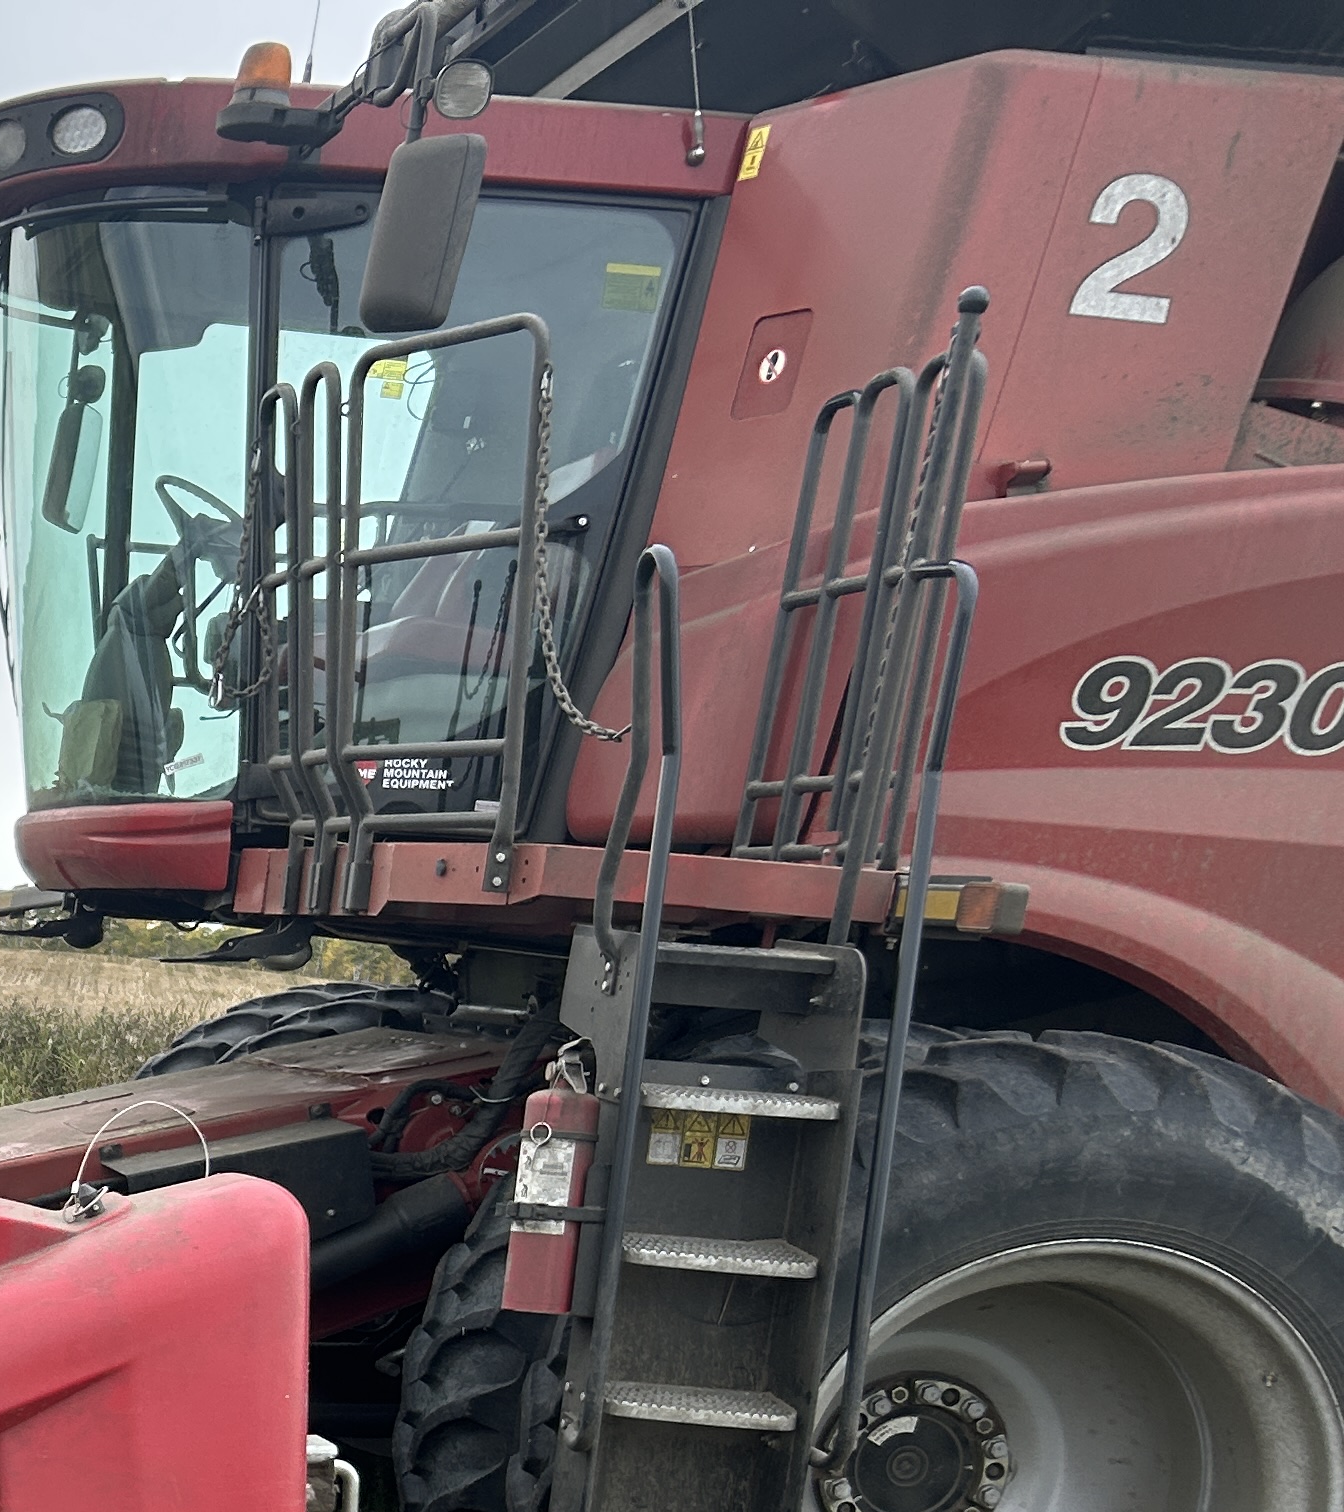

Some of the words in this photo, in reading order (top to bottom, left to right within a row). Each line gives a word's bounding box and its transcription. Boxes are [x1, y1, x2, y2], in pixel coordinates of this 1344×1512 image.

[1069, 173, 1189, 324] 2
[1059, 655, 1344, 757] 9230
[384, 758, 428, 768] ROCKY
[357, 768, 377, 779] ME
[383, 768, 448, 779] MOUNTAIN
[382, 778, 455, 790] EQUIPMENT
